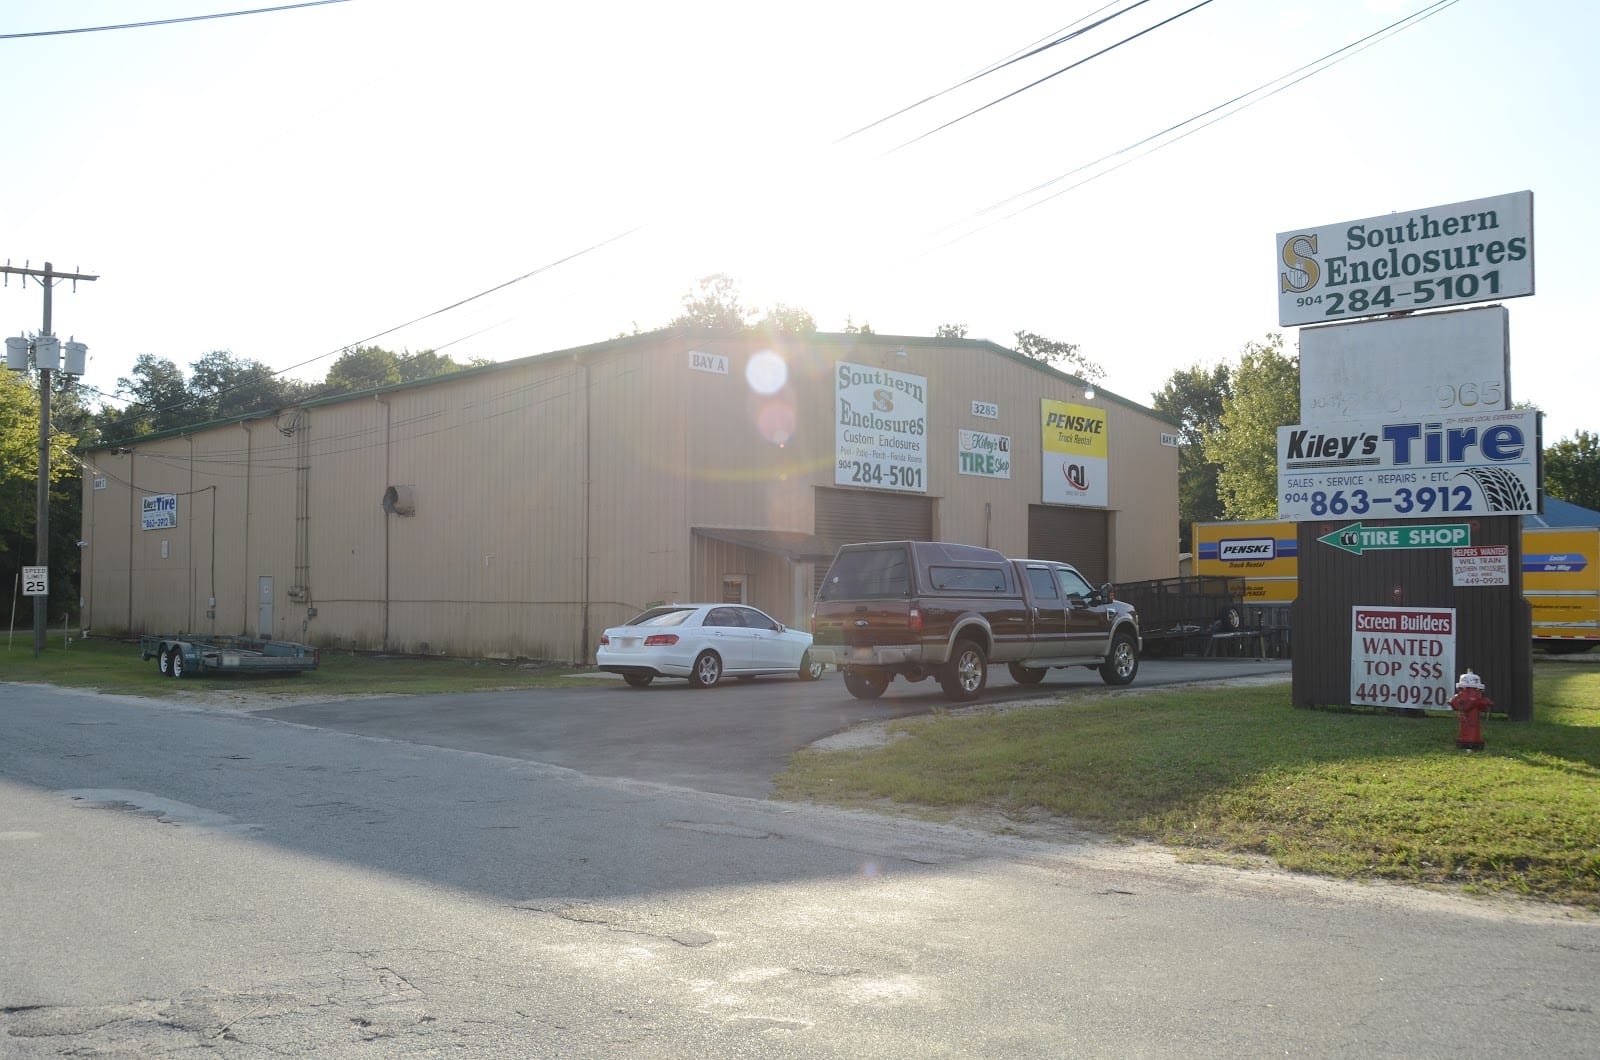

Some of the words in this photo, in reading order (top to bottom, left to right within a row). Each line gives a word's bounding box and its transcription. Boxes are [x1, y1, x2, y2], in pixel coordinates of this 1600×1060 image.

[1346, 210, 1499, 251] Southern
[1324, 236, 1527, 287] Enclosures
[1296, 296, 1322, 308] 904
[1325, 270, 1500, 316] 284-5101
[692, 354, 714, 369] BAY
[717, 358, 725, 371] A
[838, 365, 924, 403] Southern
[840, 397, 924, 436] Enclosures
[973, 403, 997, 417] 3285
[1046, 412, 1103, 434] PENSKE
[843, 429, 875, 446] Custom
[879, 434, 920, 452] Enclosures
[971, 433, 998, 453] Kiley's
[1058, 432, 1073, 443] Truck
[1074, 434, 1092, 446] Rental
[1287, 429, 1378, 460] Kiley's
[1382, 423, 1525, 466] Tire
[960, 451, 995, 474] TIRE
[994, 458, 1010, 473] Shop
[838, 459, 852, 470] 904
[852, 460, 922, 488] 284-5101
[1287, 478, 1314, 488] SALES
[1326, 476, 1364, 487] SERVICE
[1377, 473, 1417, 484] REPAIRS
[156, 497, 175, 511] Tire
[1284, 492, 1309, 503] 904
[1310, 485, 1473, 516] 863-3912
[1360, 530, 1399, 546] TIRE
[1408, 529, 1465, 545] SHOP
[1223, 545, 1271, 554] PENSKE
[1453, 548, 1478, 557] HELPERS
[1480, 547, 1507, 556] WANTED
[25, 581, 46, 592] 25
[1357, 613, 1397, 630] Screen
[1401, 615, 1450, 632] Builders
[1362, 637, 1443, 657] WANTED
[1364, 660, 1402, 677] TOP
[1409, 661, 1443, 679] $$$
[1356, 683, 1447, 706] 449-0920
